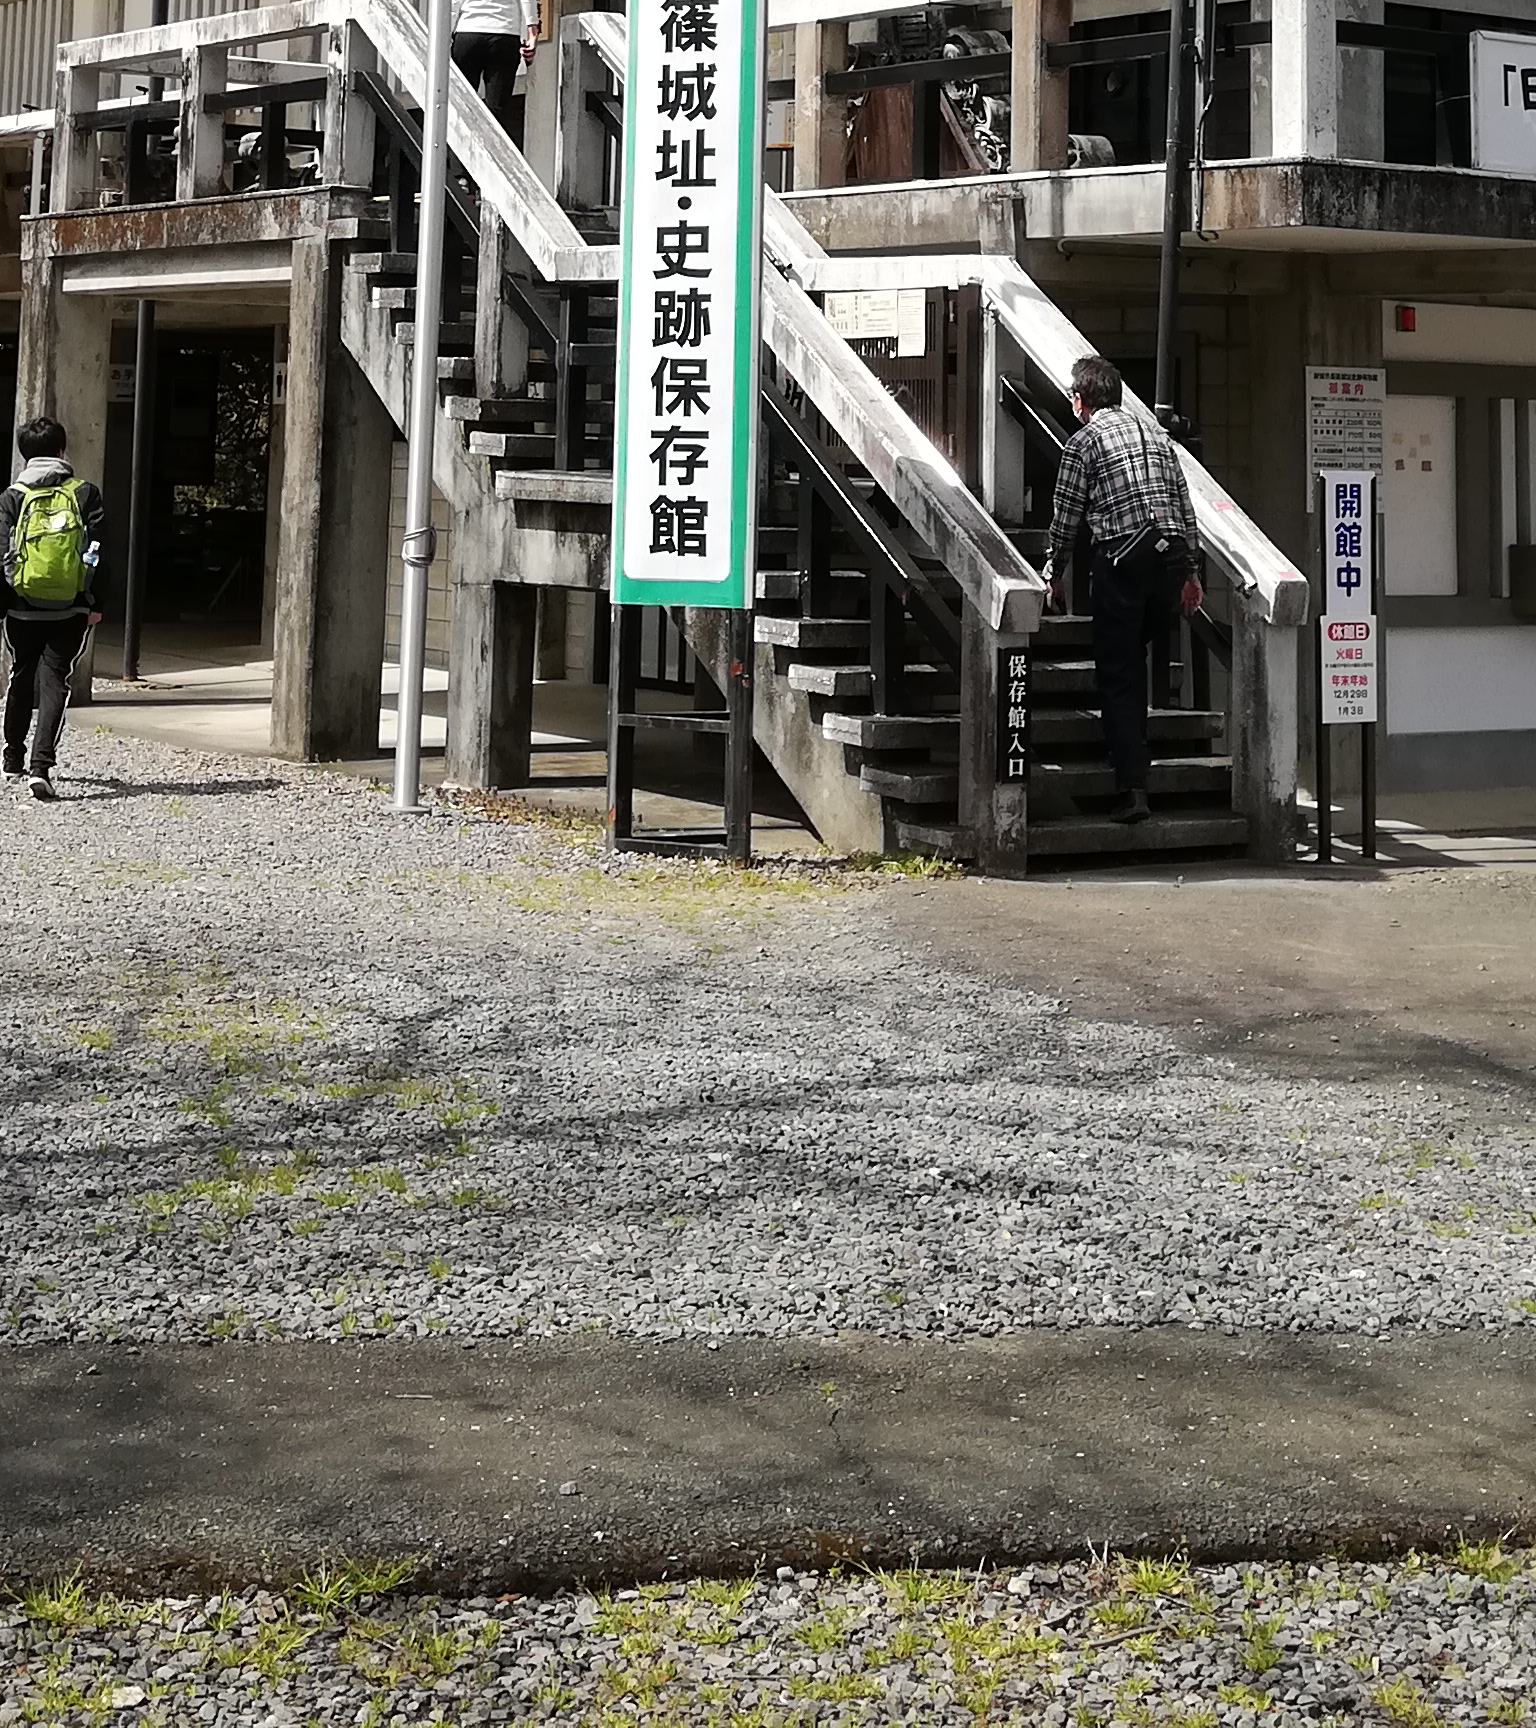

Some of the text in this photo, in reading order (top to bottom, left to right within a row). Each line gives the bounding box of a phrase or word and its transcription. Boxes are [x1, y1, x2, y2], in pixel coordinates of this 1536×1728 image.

[1335, 483, 1363, 597] 開館中
[1331, 624, 1367, 640] 休館日
[1336, 648, 1363, 660] 火曜日
[1331, 674, 1369, 686] 年末年始
[1333, 689, 1368, 699] 12月29日
[1007, 654, 1027, 777] 保存館入口
[1338, 706, 1364, 716] 1月3日
